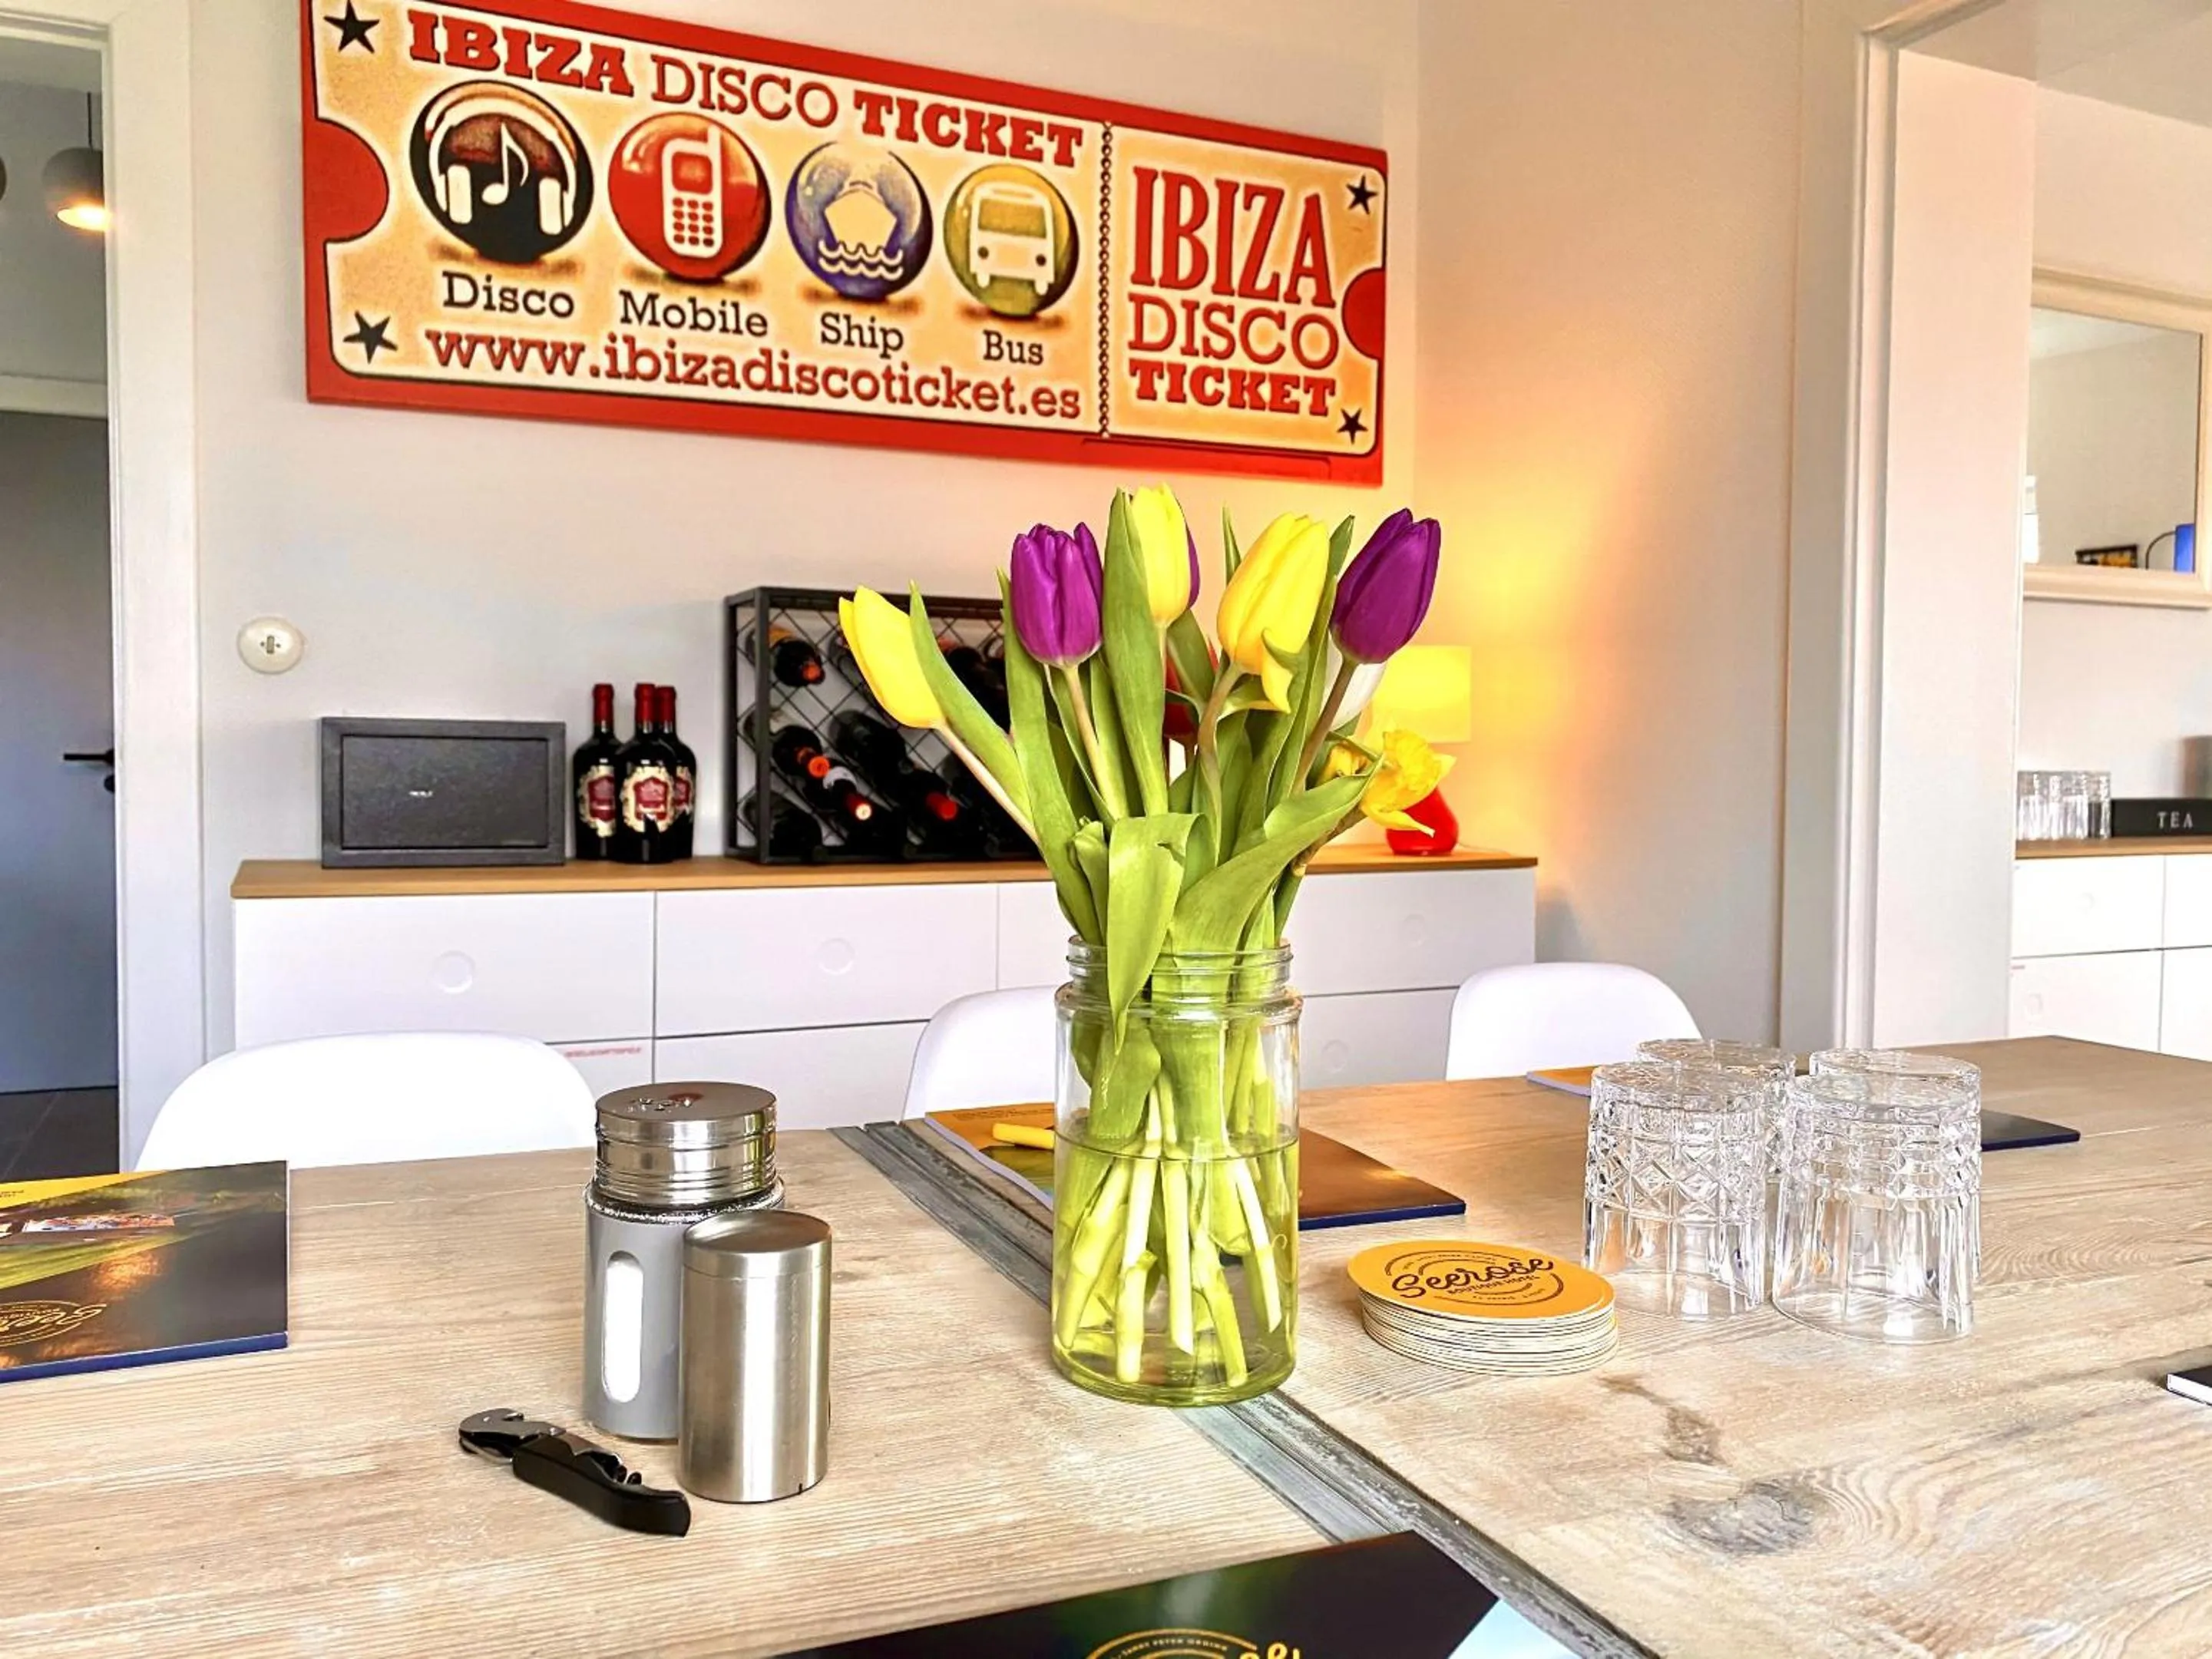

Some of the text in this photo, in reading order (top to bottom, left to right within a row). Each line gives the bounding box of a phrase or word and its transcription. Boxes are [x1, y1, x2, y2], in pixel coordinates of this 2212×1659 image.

[408, 9, 1083, 167] IBIZA DISCO TICKET
[1130, 166, 1337, 308] IBIZA
[441, 270, 574, 319] Disco
[618, 289, 769, 338] Mobile
[820, 311, 904, 357] Ship
[982, 329, 1044, 366] Bus
[1128, 293, 1339, 370] DISCO
[425, 329, 1081, 420] www.ibizadiscoticket.es
[1128, 359, 1336, 417] TICKET
[2157, 811, 2194, 828] TEA
[1392, 1258, 1553, 1298] Seerose
